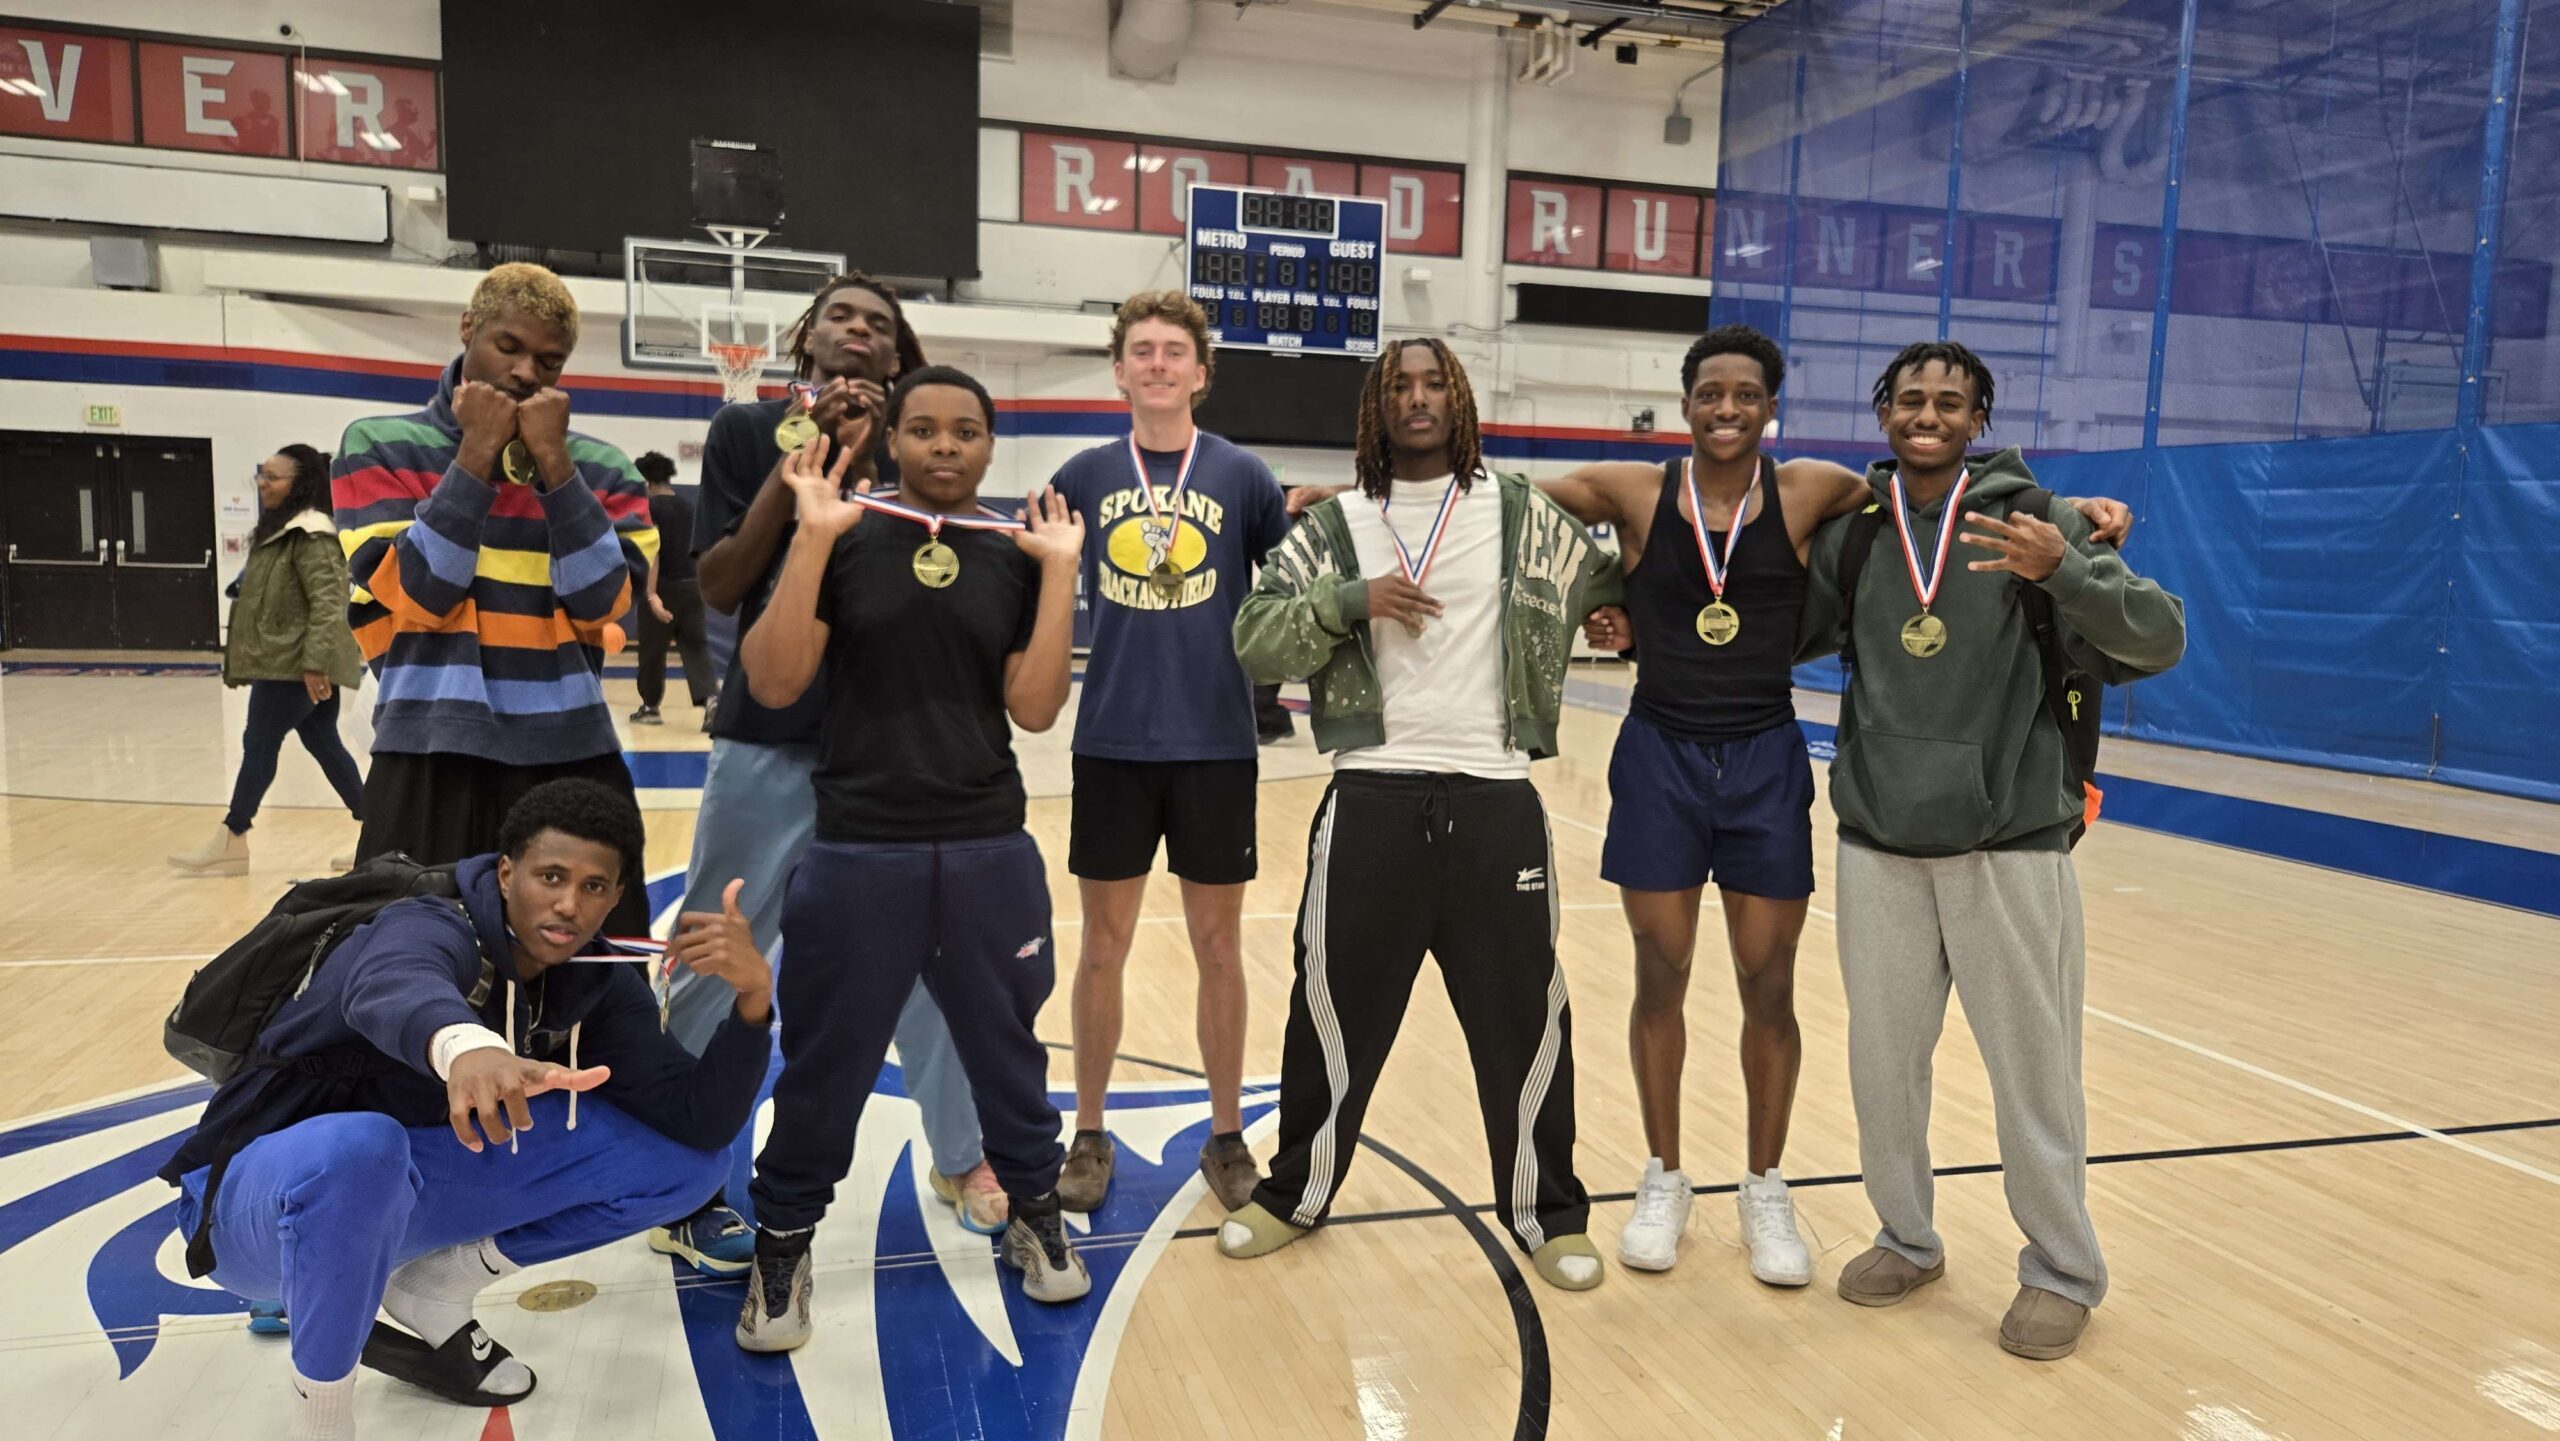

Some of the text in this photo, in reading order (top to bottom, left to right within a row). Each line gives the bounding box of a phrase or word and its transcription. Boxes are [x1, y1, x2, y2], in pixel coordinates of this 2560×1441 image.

[1197, 229, 1376, 259] METRO PERIOD GUEST
[1192, 286, 1224, 299] FOULS
[1252, 289, 1290, 304] PLAYER
[1294, 292, 1319, 307] FOUL
[1347, 296, 1378, 310] FOULS
[1267, 333, 1376, 352] MATCH SCORE
[90, 405, 114, 422] EXIT
[1099, 484, 1224, 535] SPOKANE
[1516, 883, 1530, 891] THE
